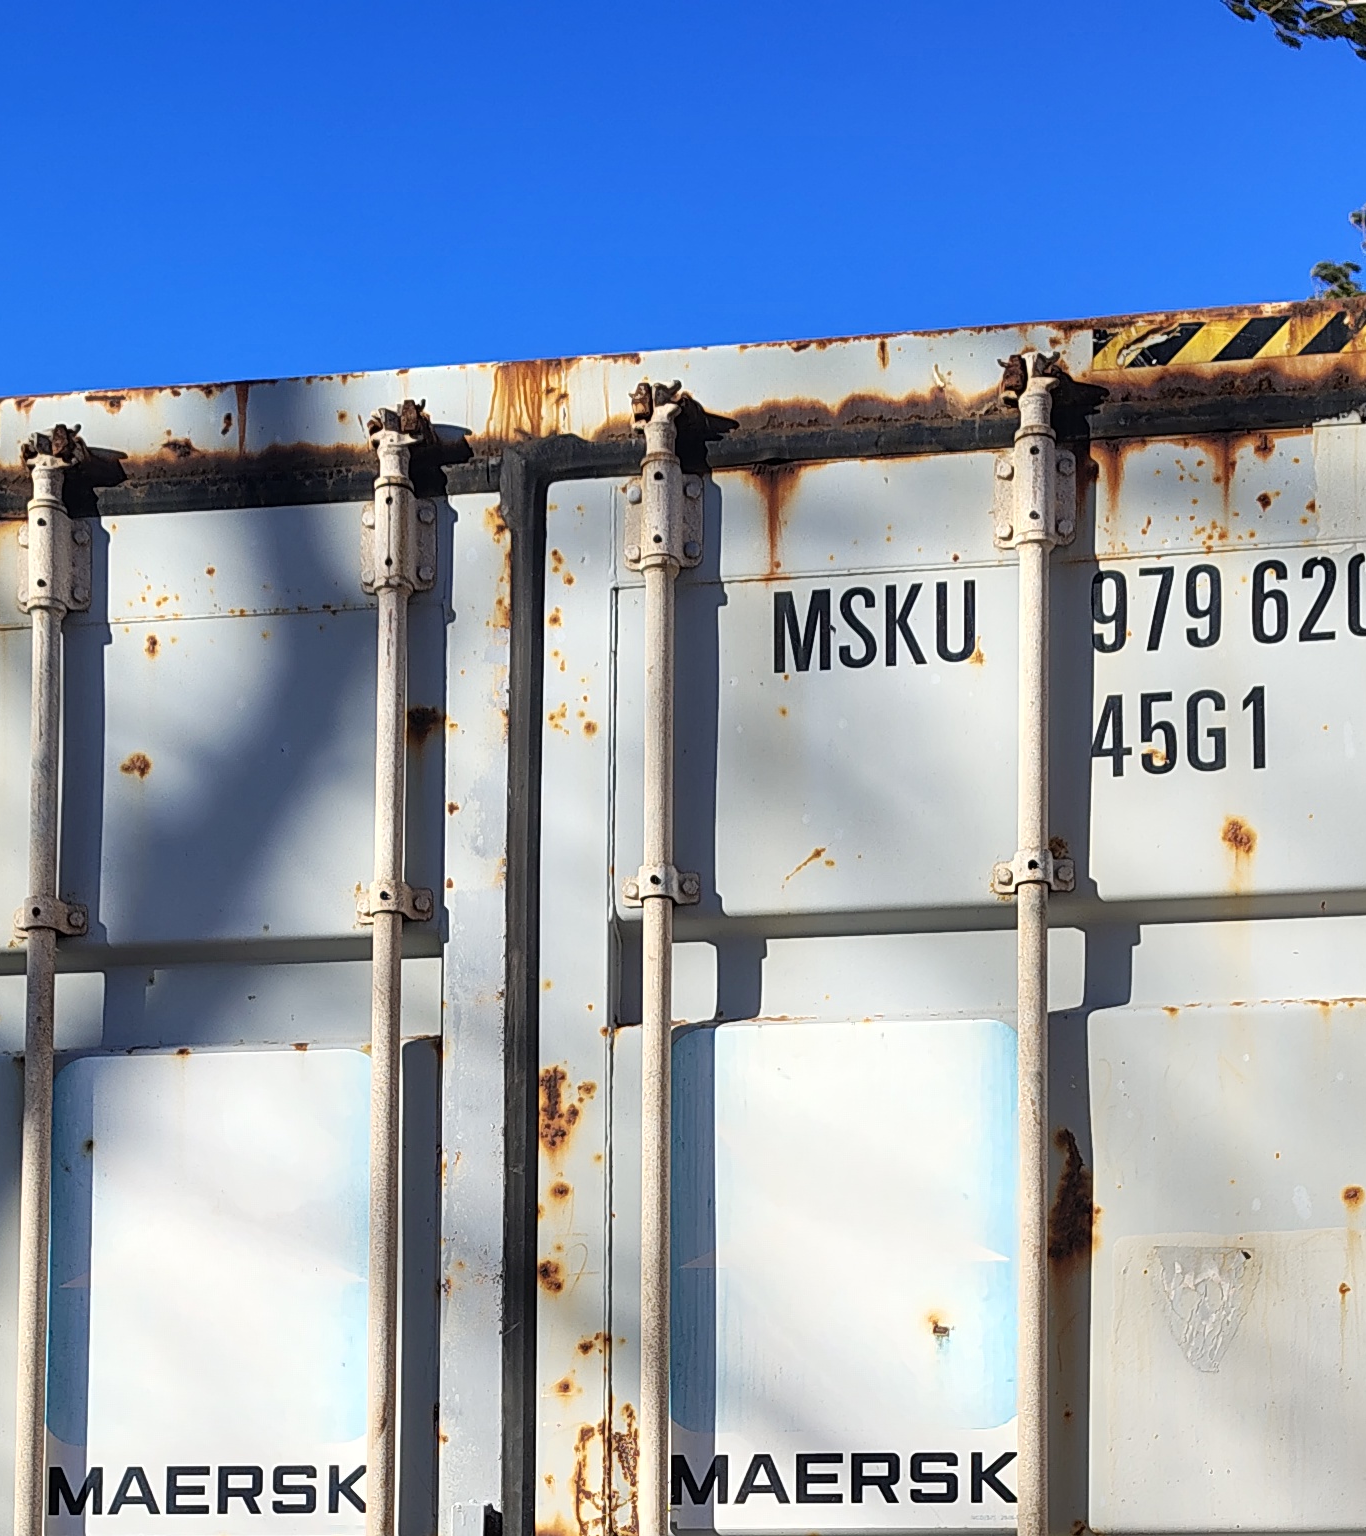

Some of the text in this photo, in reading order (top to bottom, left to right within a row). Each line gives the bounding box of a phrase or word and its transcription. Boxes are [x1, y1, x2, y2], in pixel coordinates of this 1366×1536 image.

[772, 579, 977, 674] MSKU
[1091, 563, 1223, 654] 979
[1091, 685, 1268, 778] 45G1
[48, 1464, 367, 1516] MAERSK
[670, 1451, 1018, 1504] MAERSK
